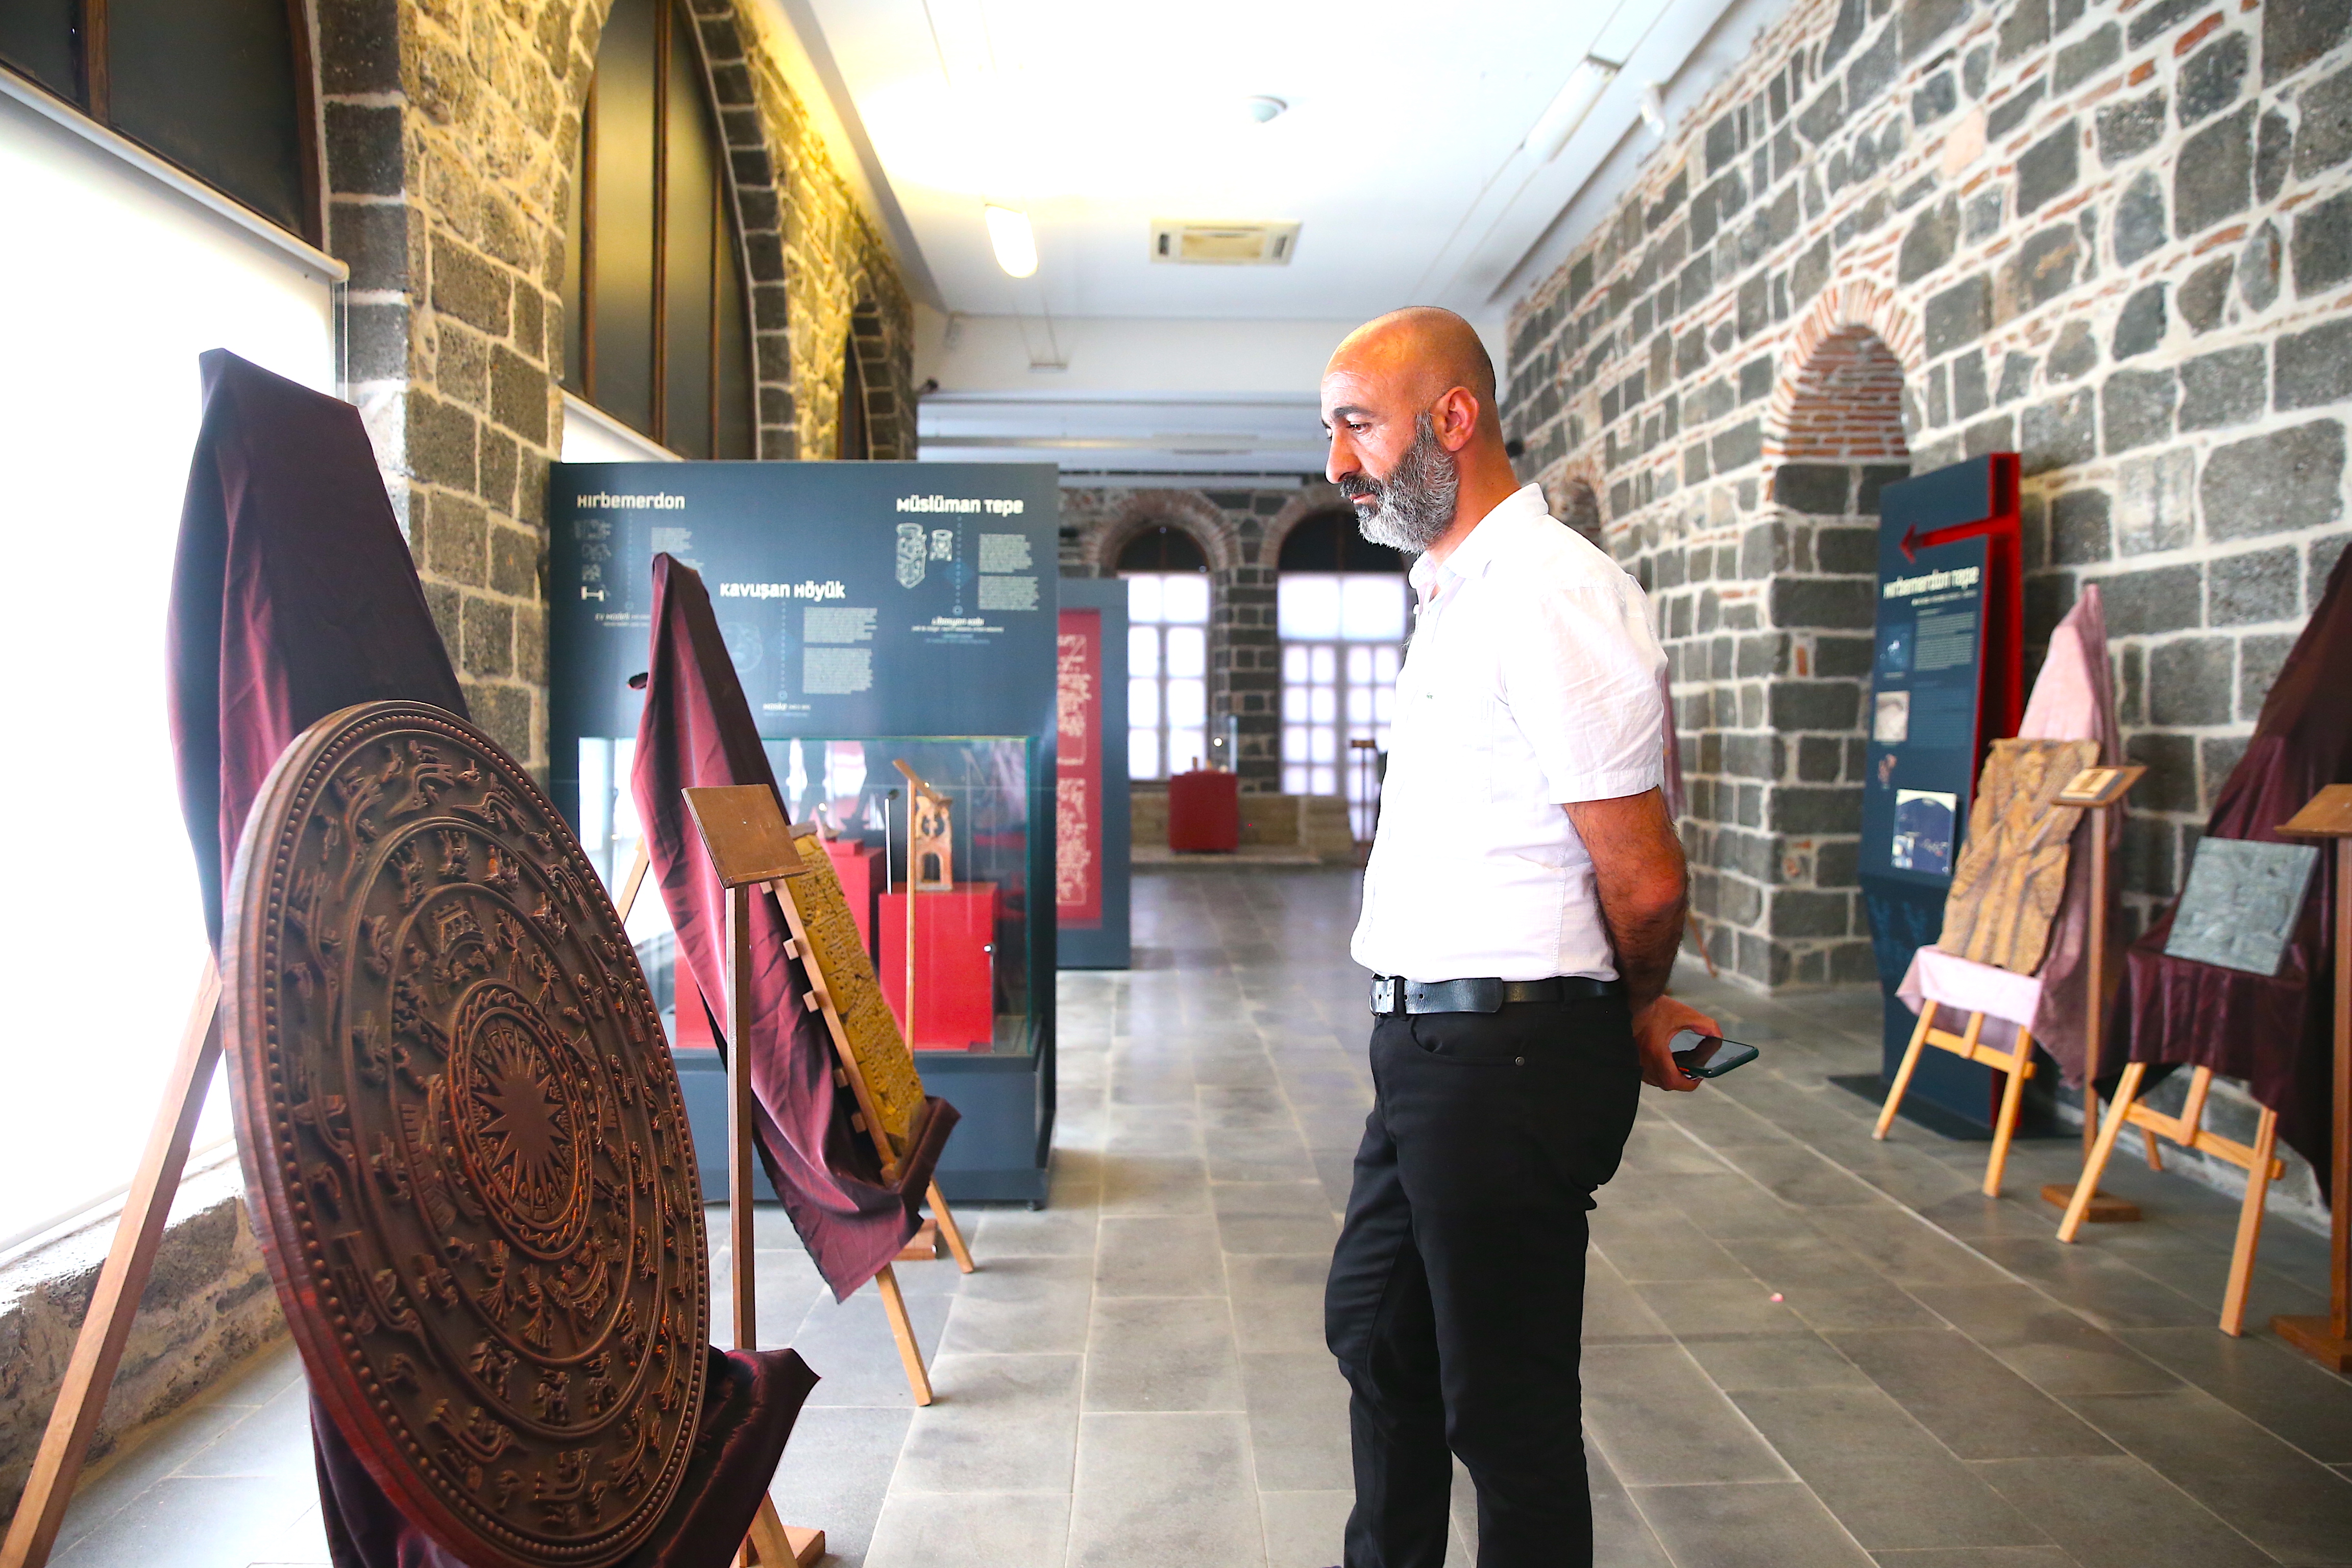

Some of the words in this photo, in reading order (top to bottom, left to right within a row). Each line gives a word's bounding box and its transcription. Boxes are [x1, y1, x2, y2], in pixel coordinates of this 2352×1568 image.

[577, 491, 685, 509] Hırbemerdon
[896, 494, 982, 513] Müslüman
[984, 499, 1024, 517] Tepe
[720, 583, 791, 600] Kavuşan
[794, 580, 846, 602] Höyük
